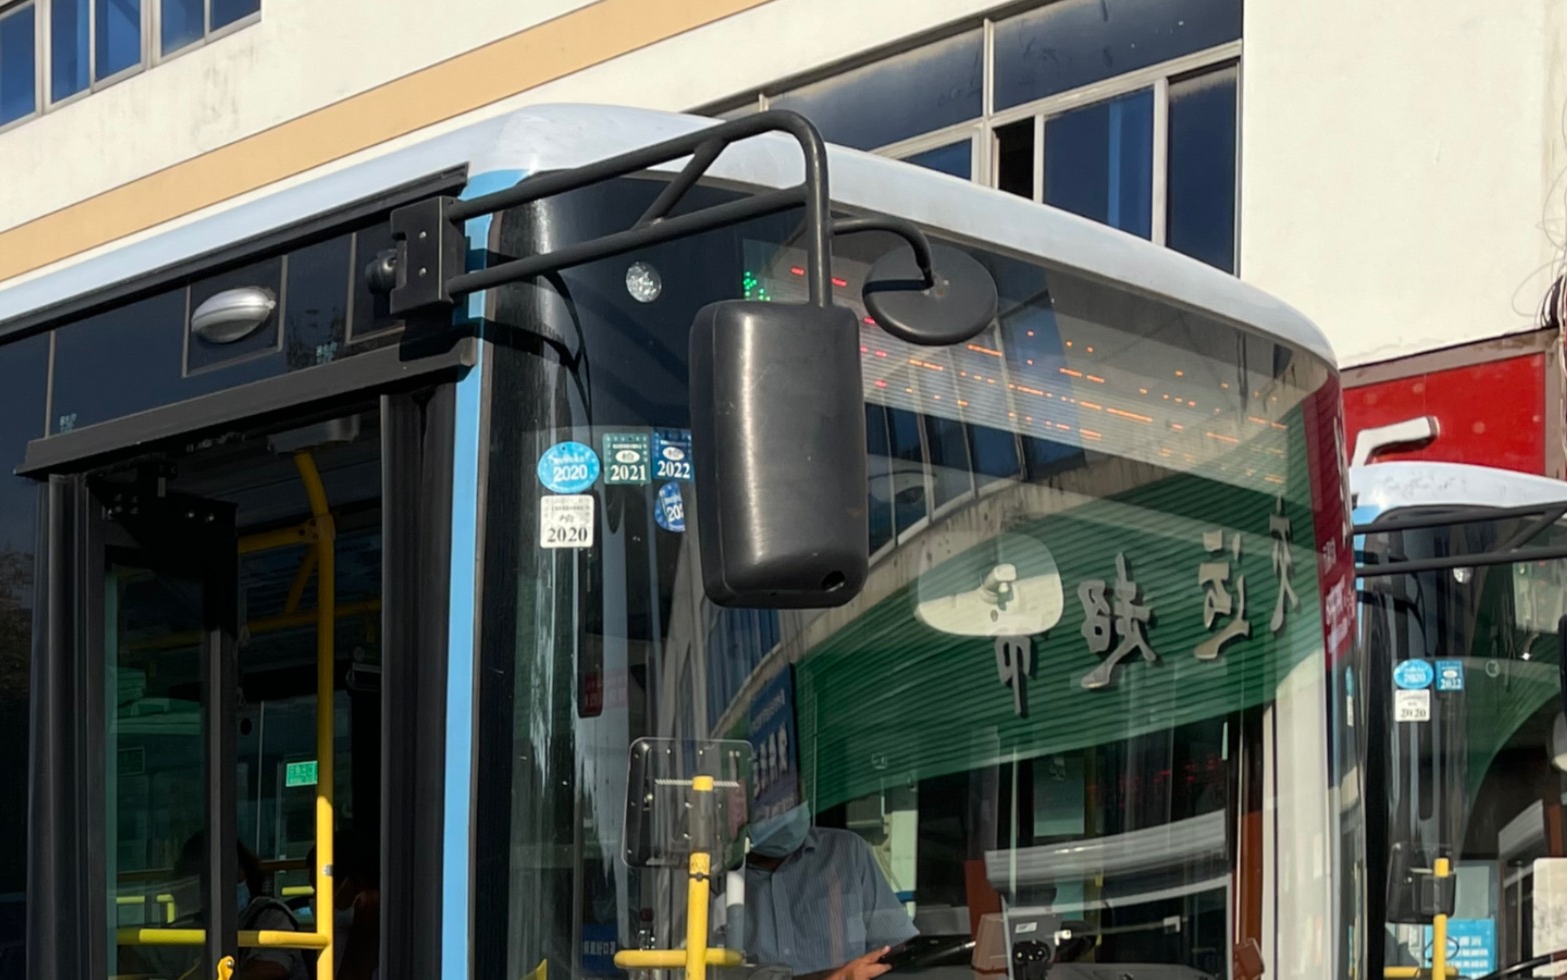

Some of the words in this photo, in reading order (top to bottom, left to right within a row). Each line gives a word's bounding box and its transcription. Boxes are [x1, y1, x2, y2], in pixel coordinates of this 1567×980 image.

[553, 465, 588, 482] 2020
[610, 464, 647, 481] 2021
[657, 460, 691, 480] 2022
[547, 527, 588, 543] 2020
